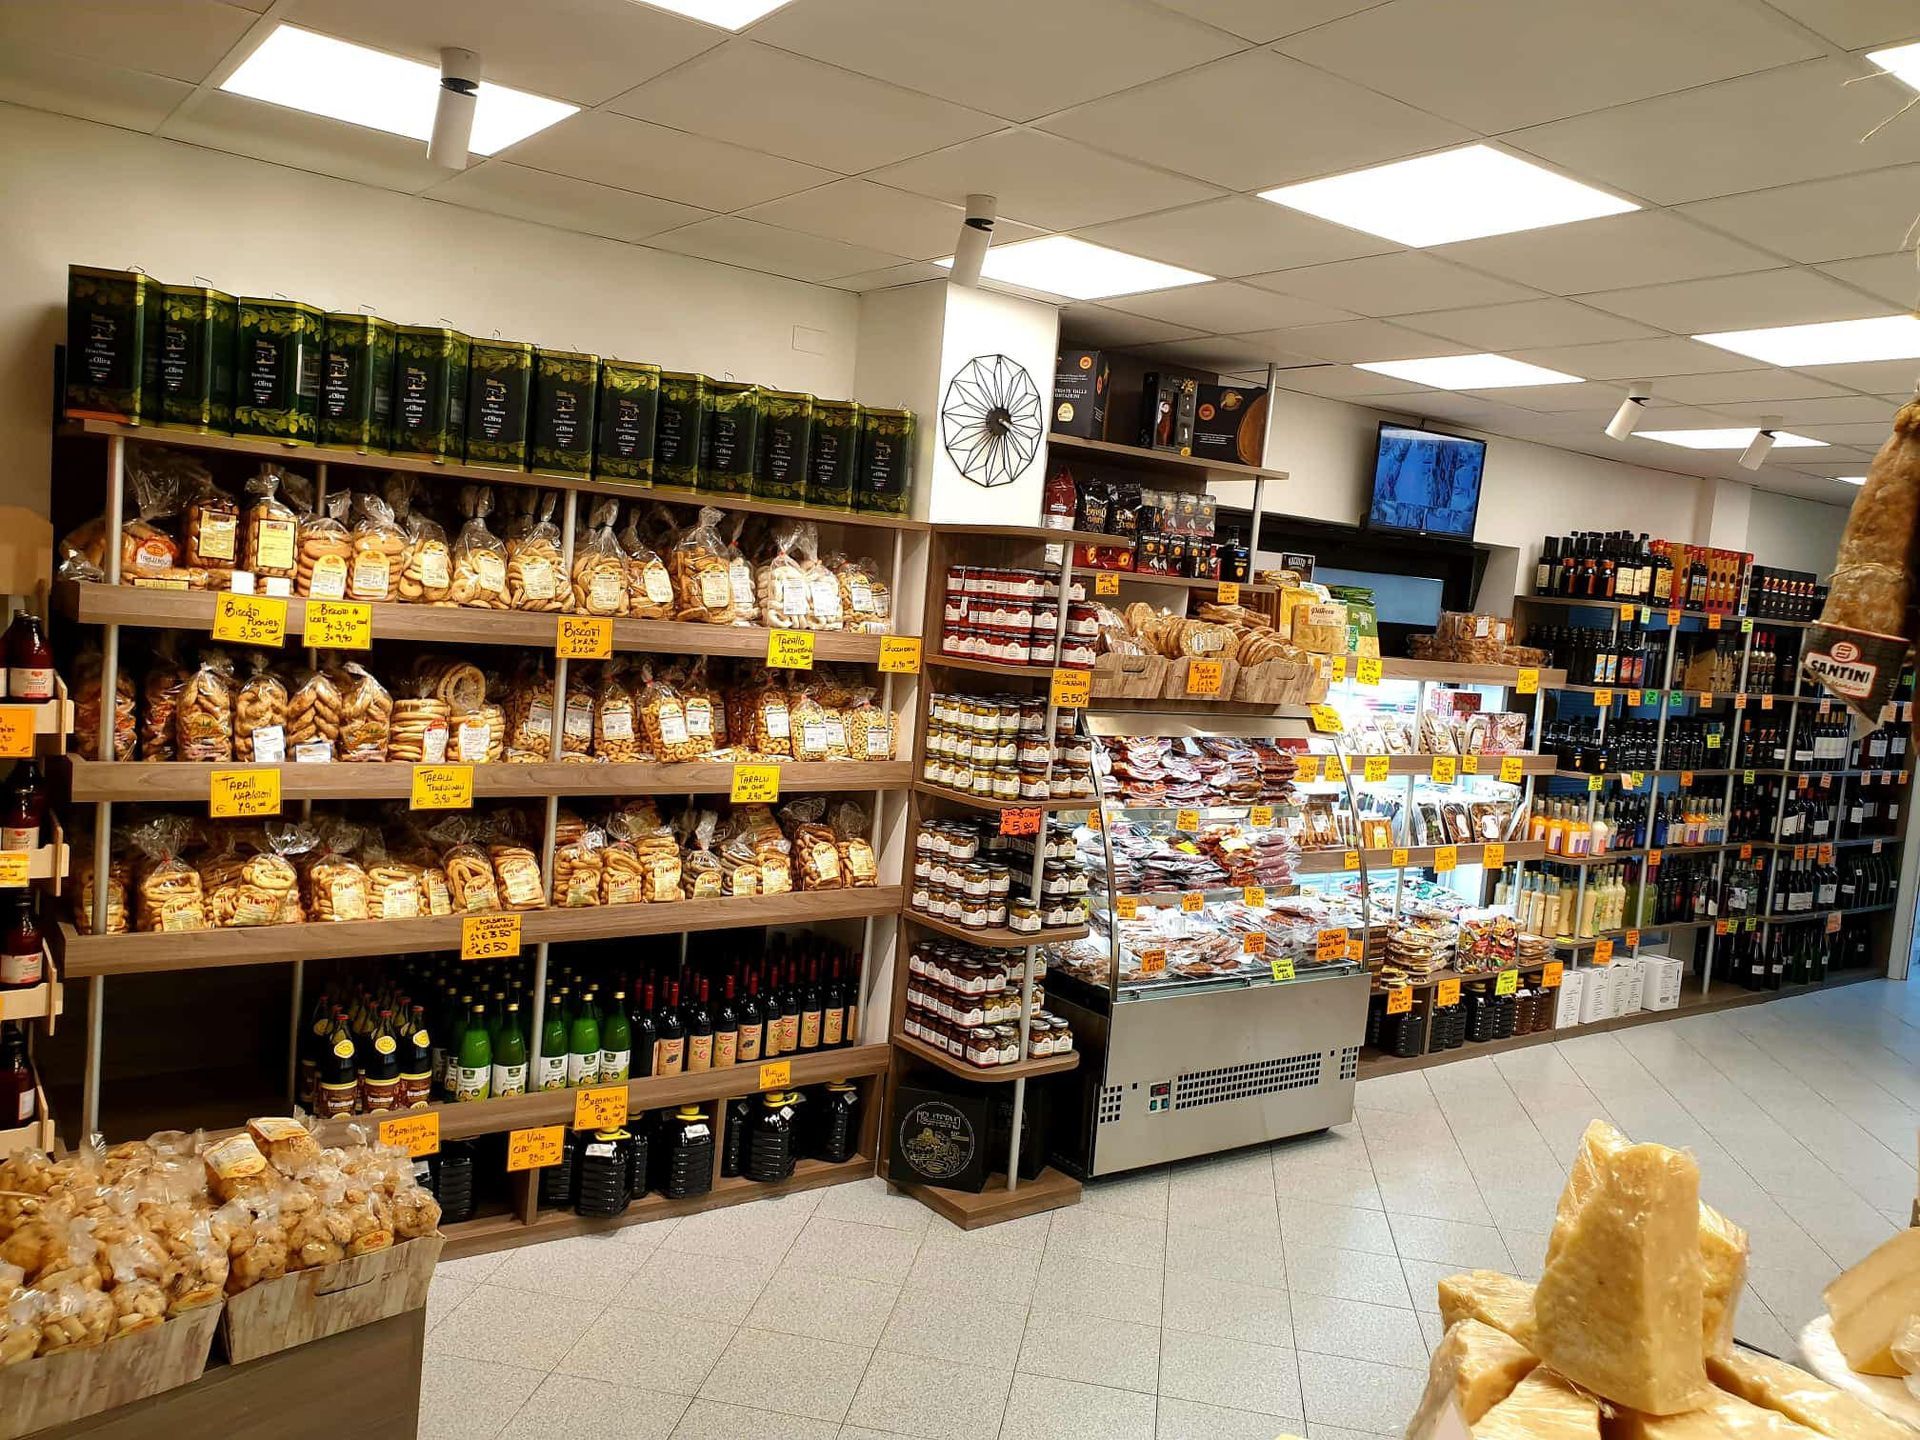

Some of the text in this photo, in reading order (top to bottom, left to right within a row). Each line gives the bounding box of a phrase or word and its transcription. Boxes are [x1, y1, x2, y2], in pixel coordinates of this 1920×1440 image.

[334, 621, 357, 632] 3,90
[239, 627, 262, 640] 3,50
[1811, 659, 1871, 684] SANTINI
